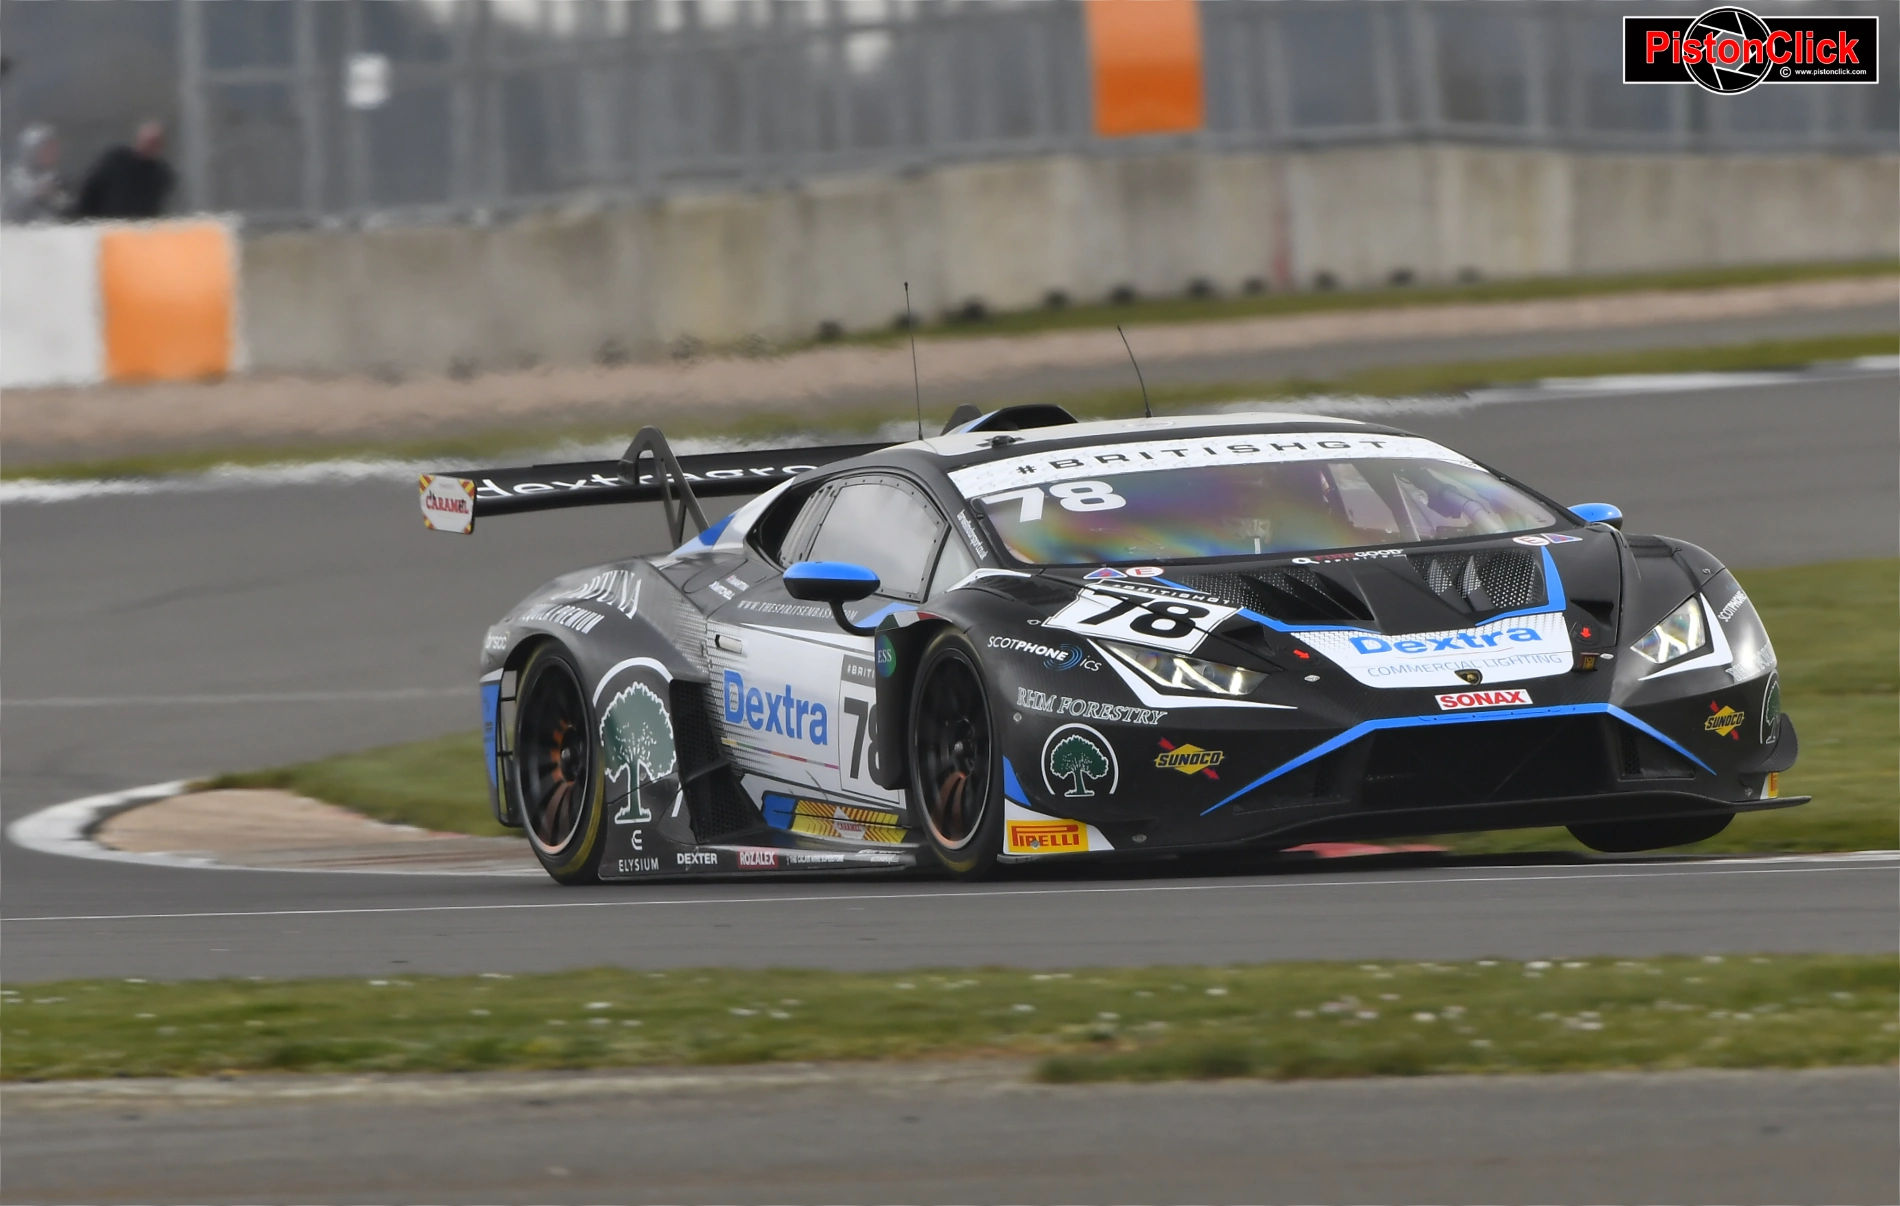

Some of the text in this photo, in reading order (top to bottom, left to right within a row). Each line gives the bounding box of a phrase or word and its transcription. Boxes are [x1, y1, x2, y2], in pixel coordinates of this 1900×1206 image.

[1016, 440, 1387, 475] #BRITISHGT
[426, 494, 469, 515] CARAMEL
[983, 481, 1126, 523] 78
[1077, 588, 1210, 639] 78
[987, 635, 1069, 662] SCOTPHONE
[1350, 627, 1543, 655] Dextra
[1367, 654, 1563, 677] COMMERCIAL LIGHTING
[723, 669, 828, 746] Dextra
[1017, 687, 1168, 725] RHM FORESTRY
[1440, 691, 1527, 709] SONAX
[1706, 713, 1744, 729] SUNOCO
[1157, 752, 1222, 766] SUNOCO
[1011, 824, 1080, 847] PIRELLI
[618, 857, 660, 872] ELYSIUM
[677, 853, 718, 865] DEXTER
[739, 852, 775, 866] ROZALEX
